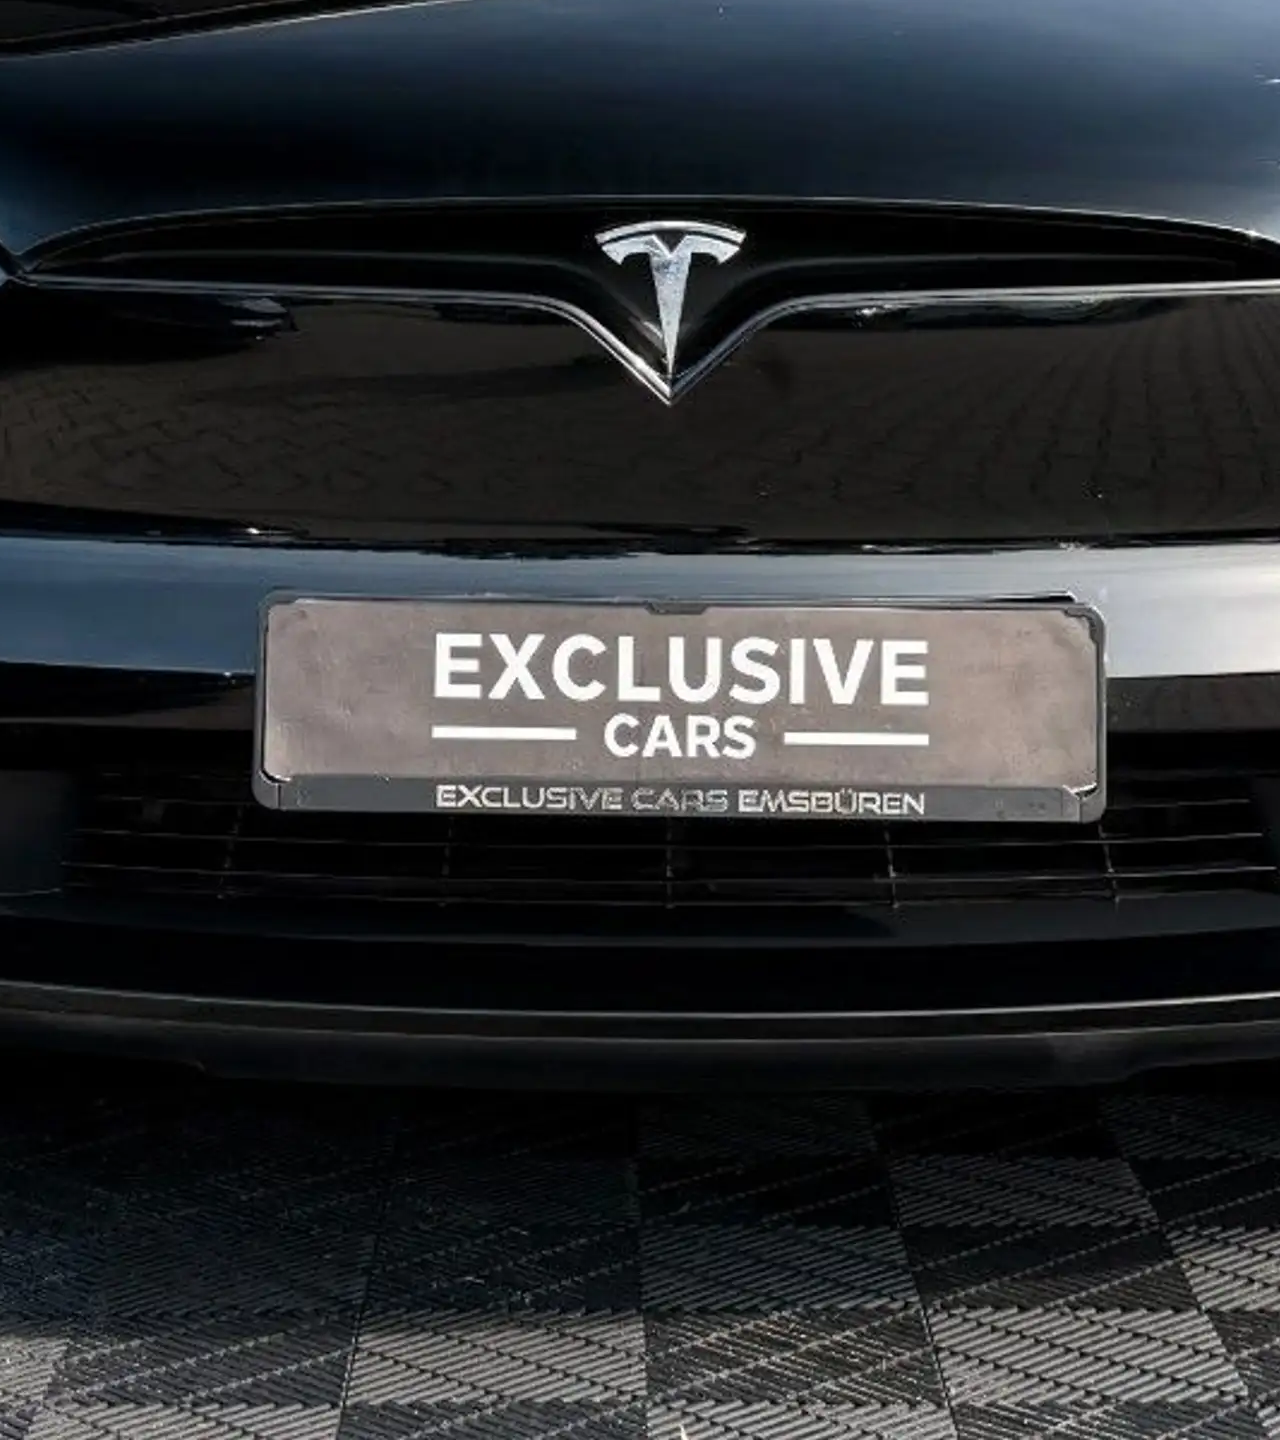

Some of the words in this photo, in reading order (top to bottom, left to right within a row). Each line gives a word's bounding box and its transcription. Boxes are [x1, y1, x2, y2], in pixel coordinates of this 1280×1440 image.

[434, 632, 930, 706] EXCLUSIVE
[603, 713, 757, 759] CARS
[435, 784, 623, 810] EXCLUSIVE
[631, 788, 728, 812] CARS
[738, 787, 926, 816] EMSBÜREN
